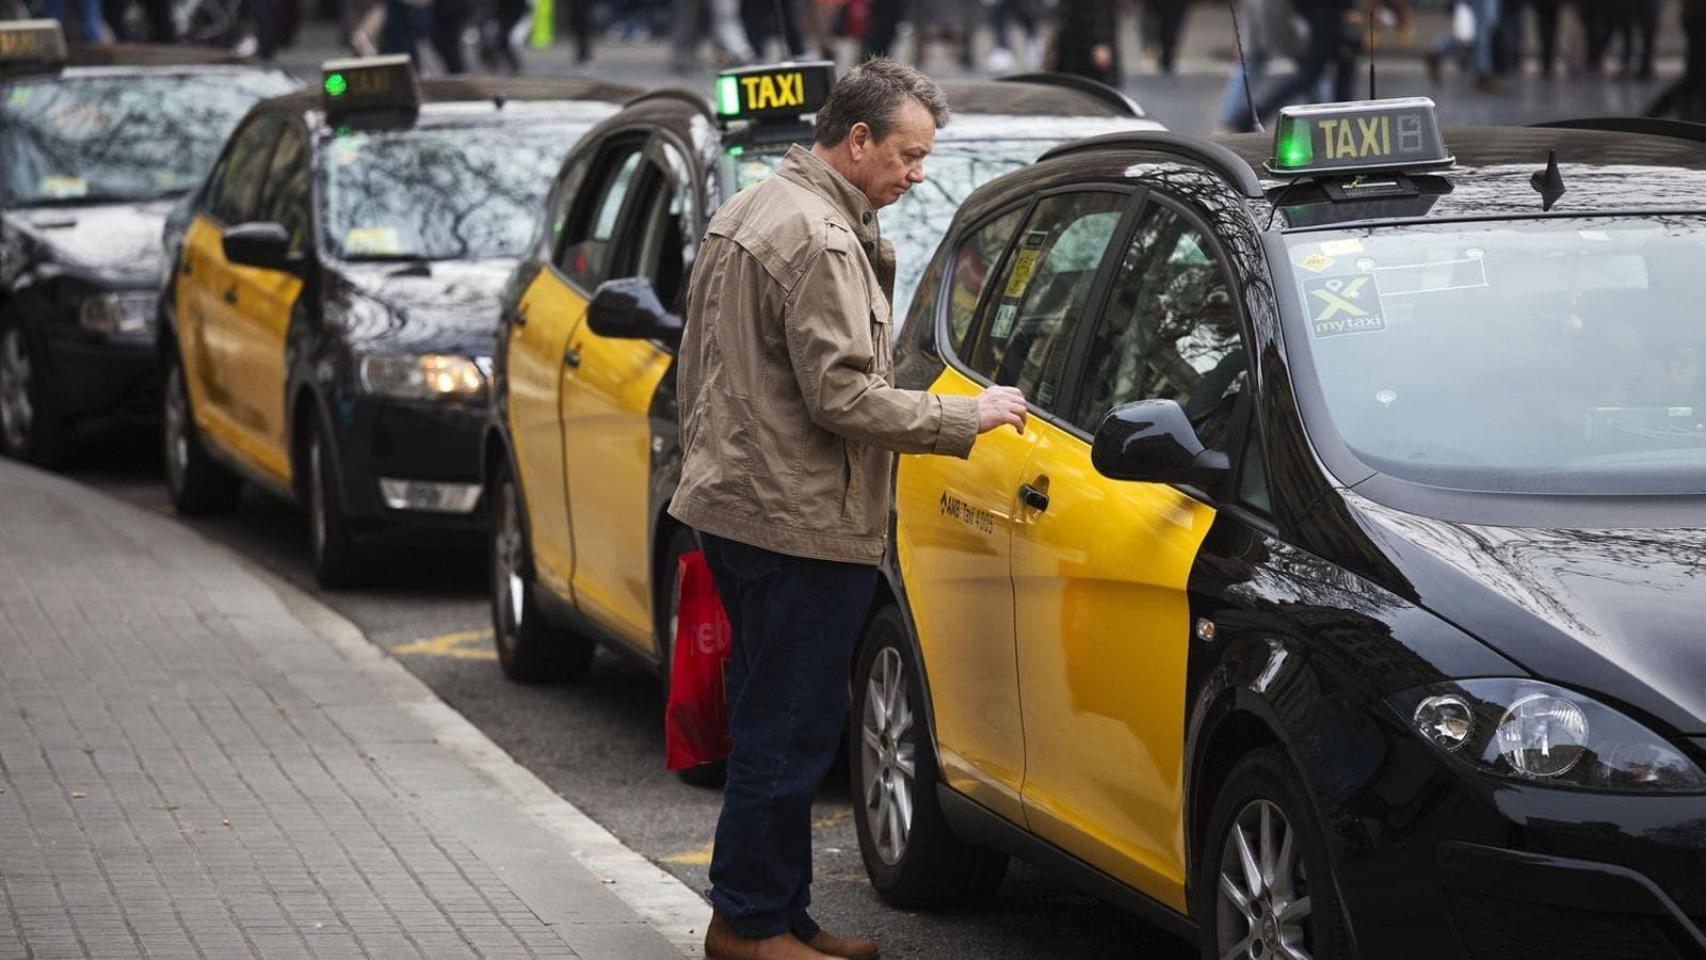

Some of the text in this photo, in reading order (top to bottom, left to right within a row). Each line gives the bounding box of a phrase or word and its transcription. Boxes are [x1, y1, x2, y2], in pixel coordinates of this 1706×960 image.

[741, 72, 804, 109] TAXI
[1319, 116, 1391, 159] TAXI
[1314, 315, 1382, 333] mytaxi
